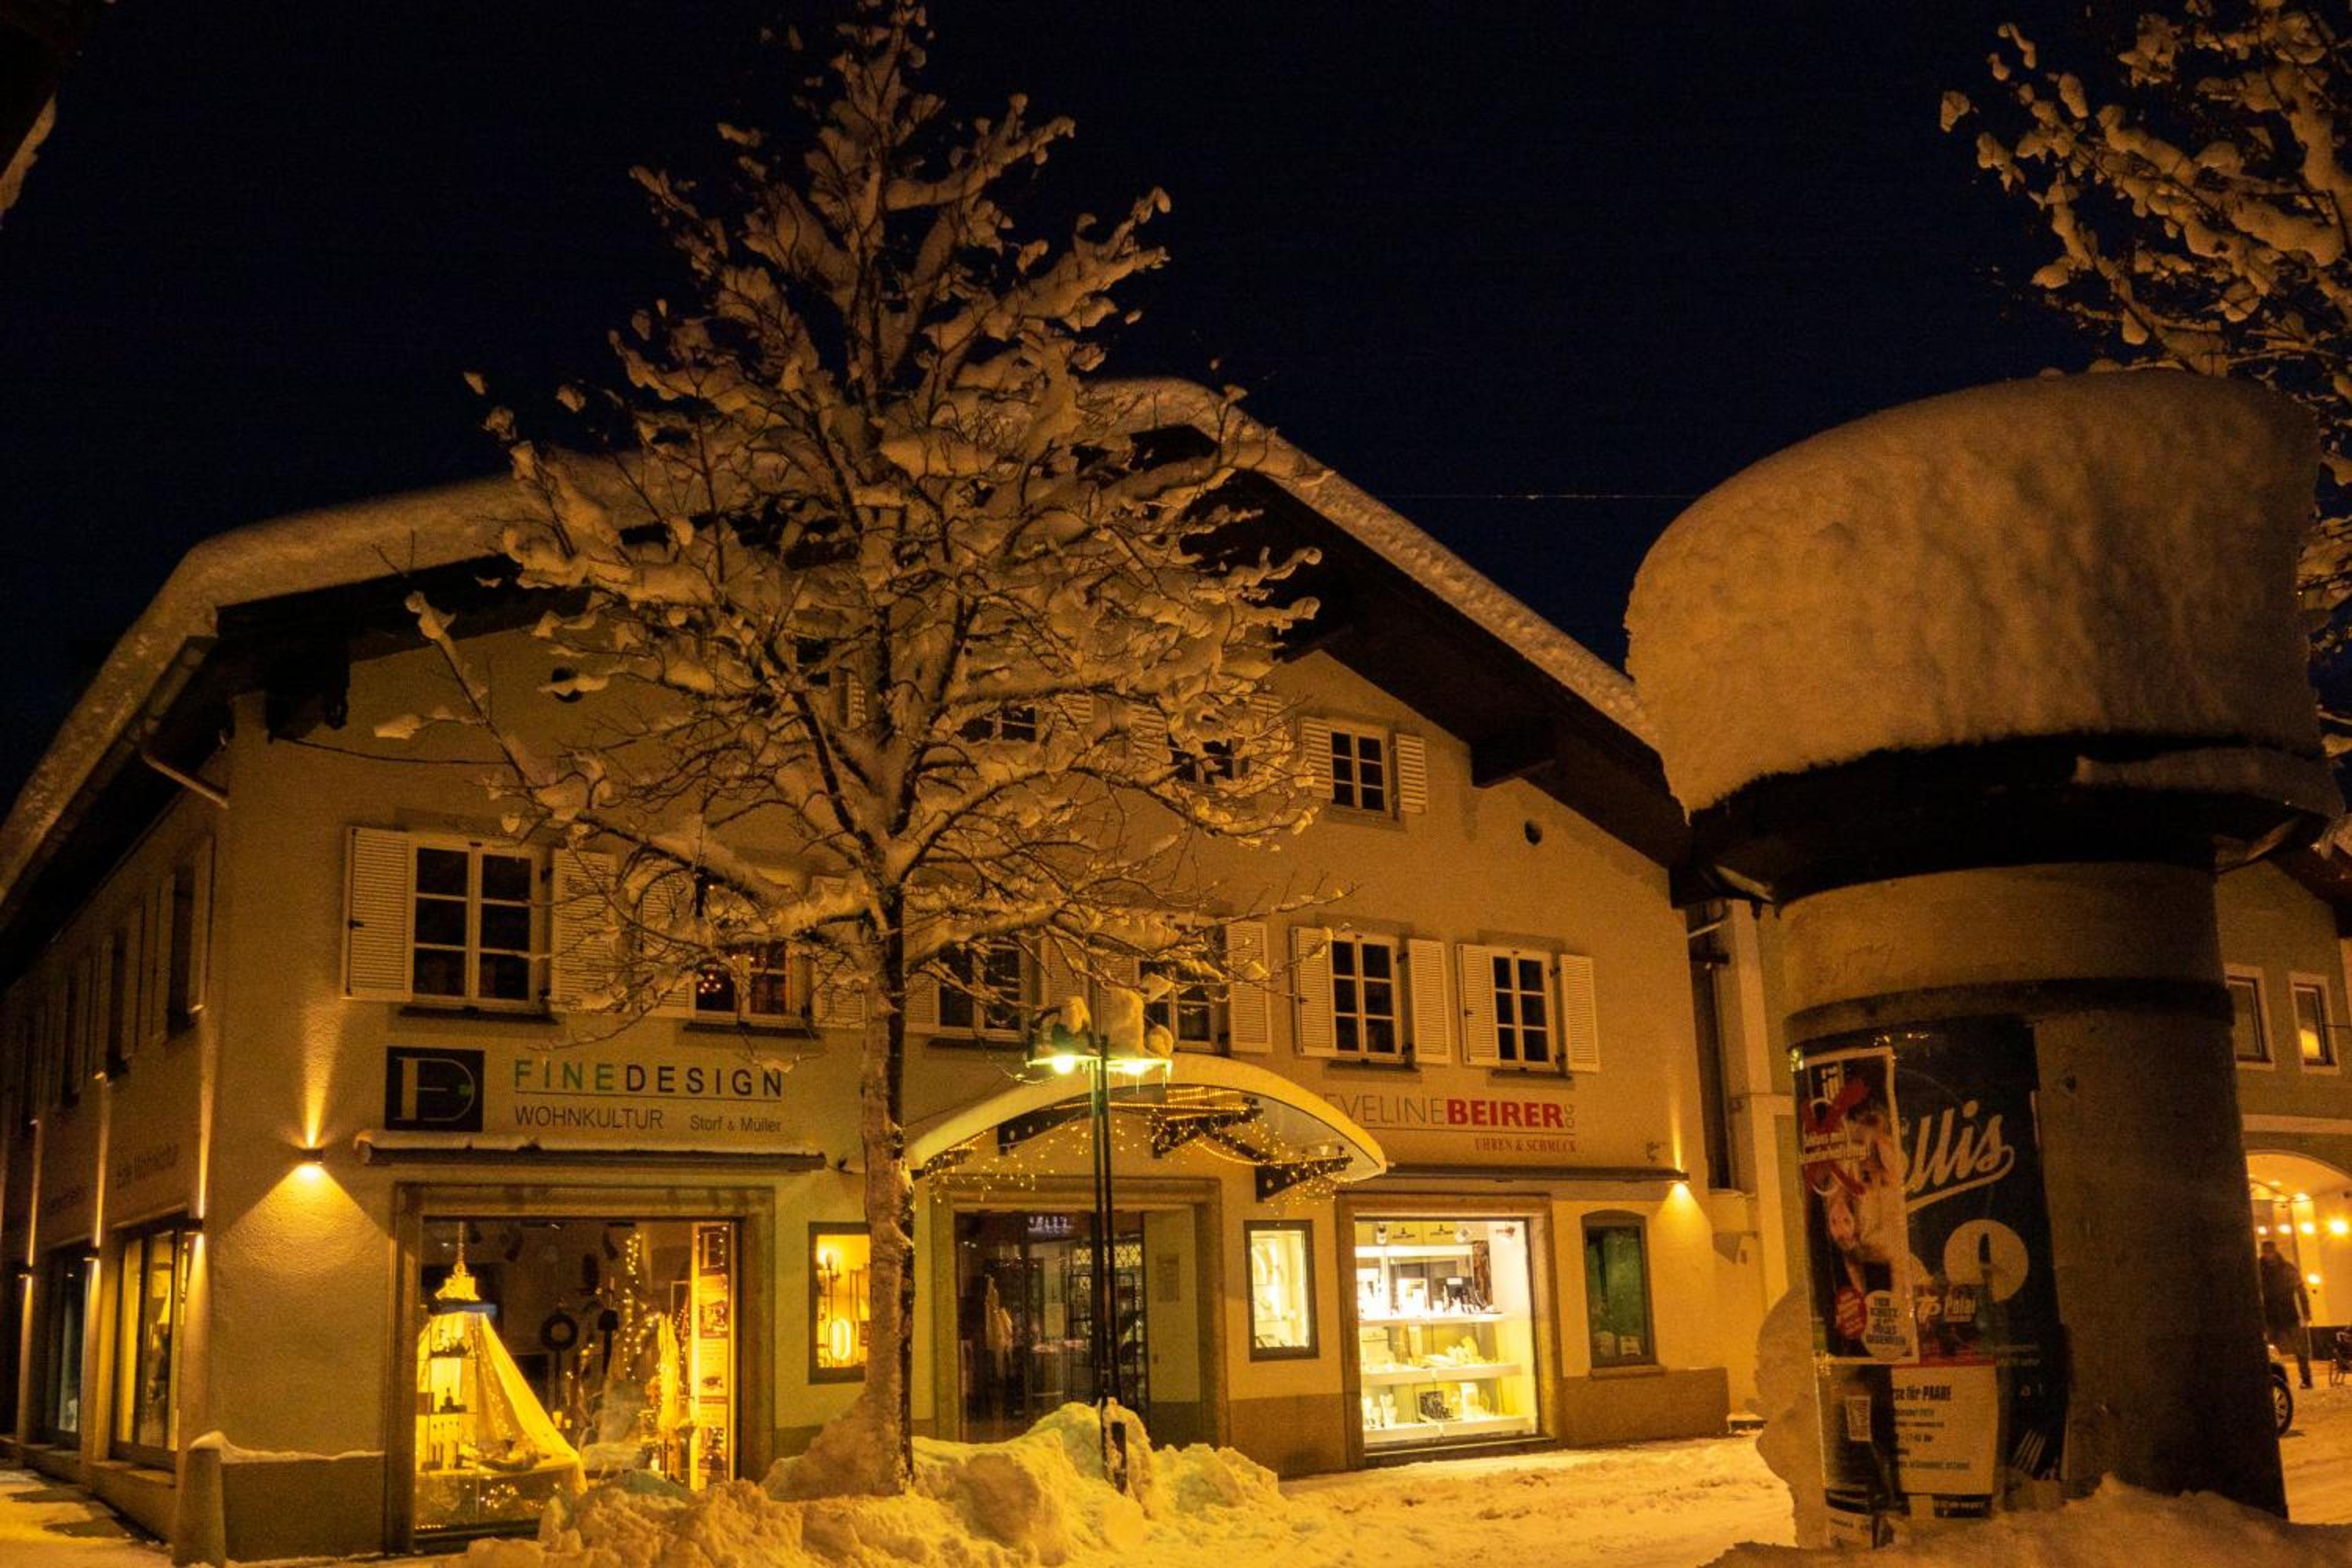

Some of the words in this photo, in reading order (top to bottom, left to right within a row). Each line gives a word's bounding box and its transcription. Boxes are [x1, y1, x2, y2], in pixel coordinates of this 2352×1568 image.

[514, 1105, 664, 1130] WOHNKULTUR
[1475, 1138, 1512, 1152] UHREN
[1526, 1139, 1577, 1153] SCHMUCK
